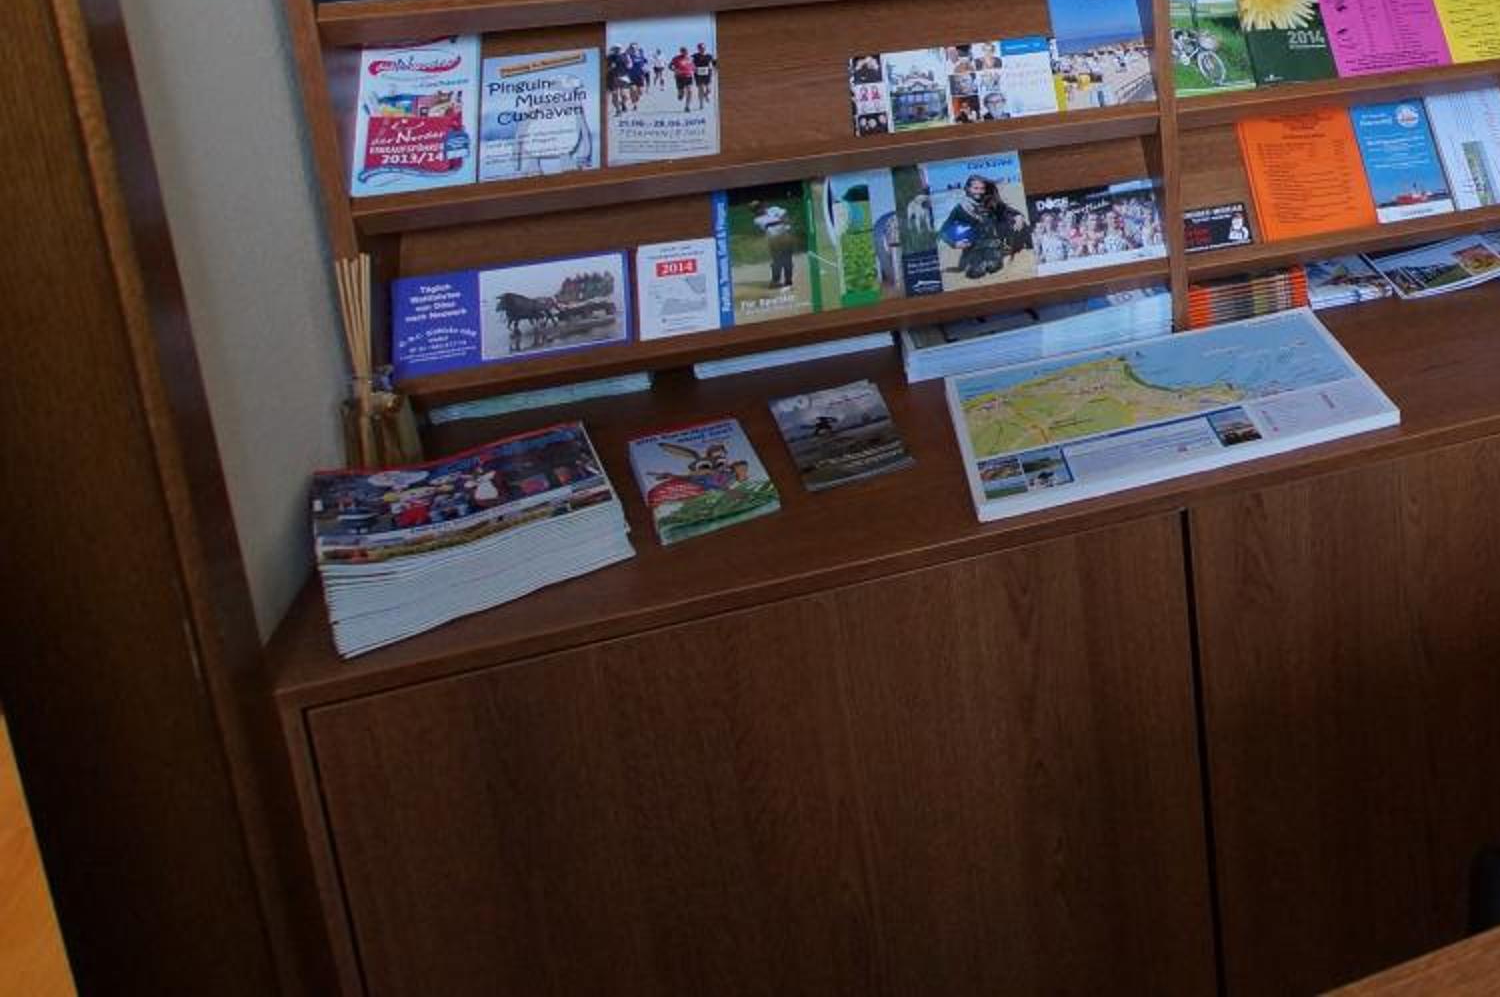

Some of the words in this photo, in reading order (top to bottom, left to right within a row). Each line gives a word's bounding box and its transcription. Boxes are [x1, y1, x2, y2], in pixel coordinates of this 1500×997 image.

[1287, 29, 1326, 45] 2014
[489, 77, 551, 97] Pinguin
[514, 89, 587, 108] Museum
[497, 105, 584, 126] Cuxhaven
[660, 262, 695, 277] 2014
